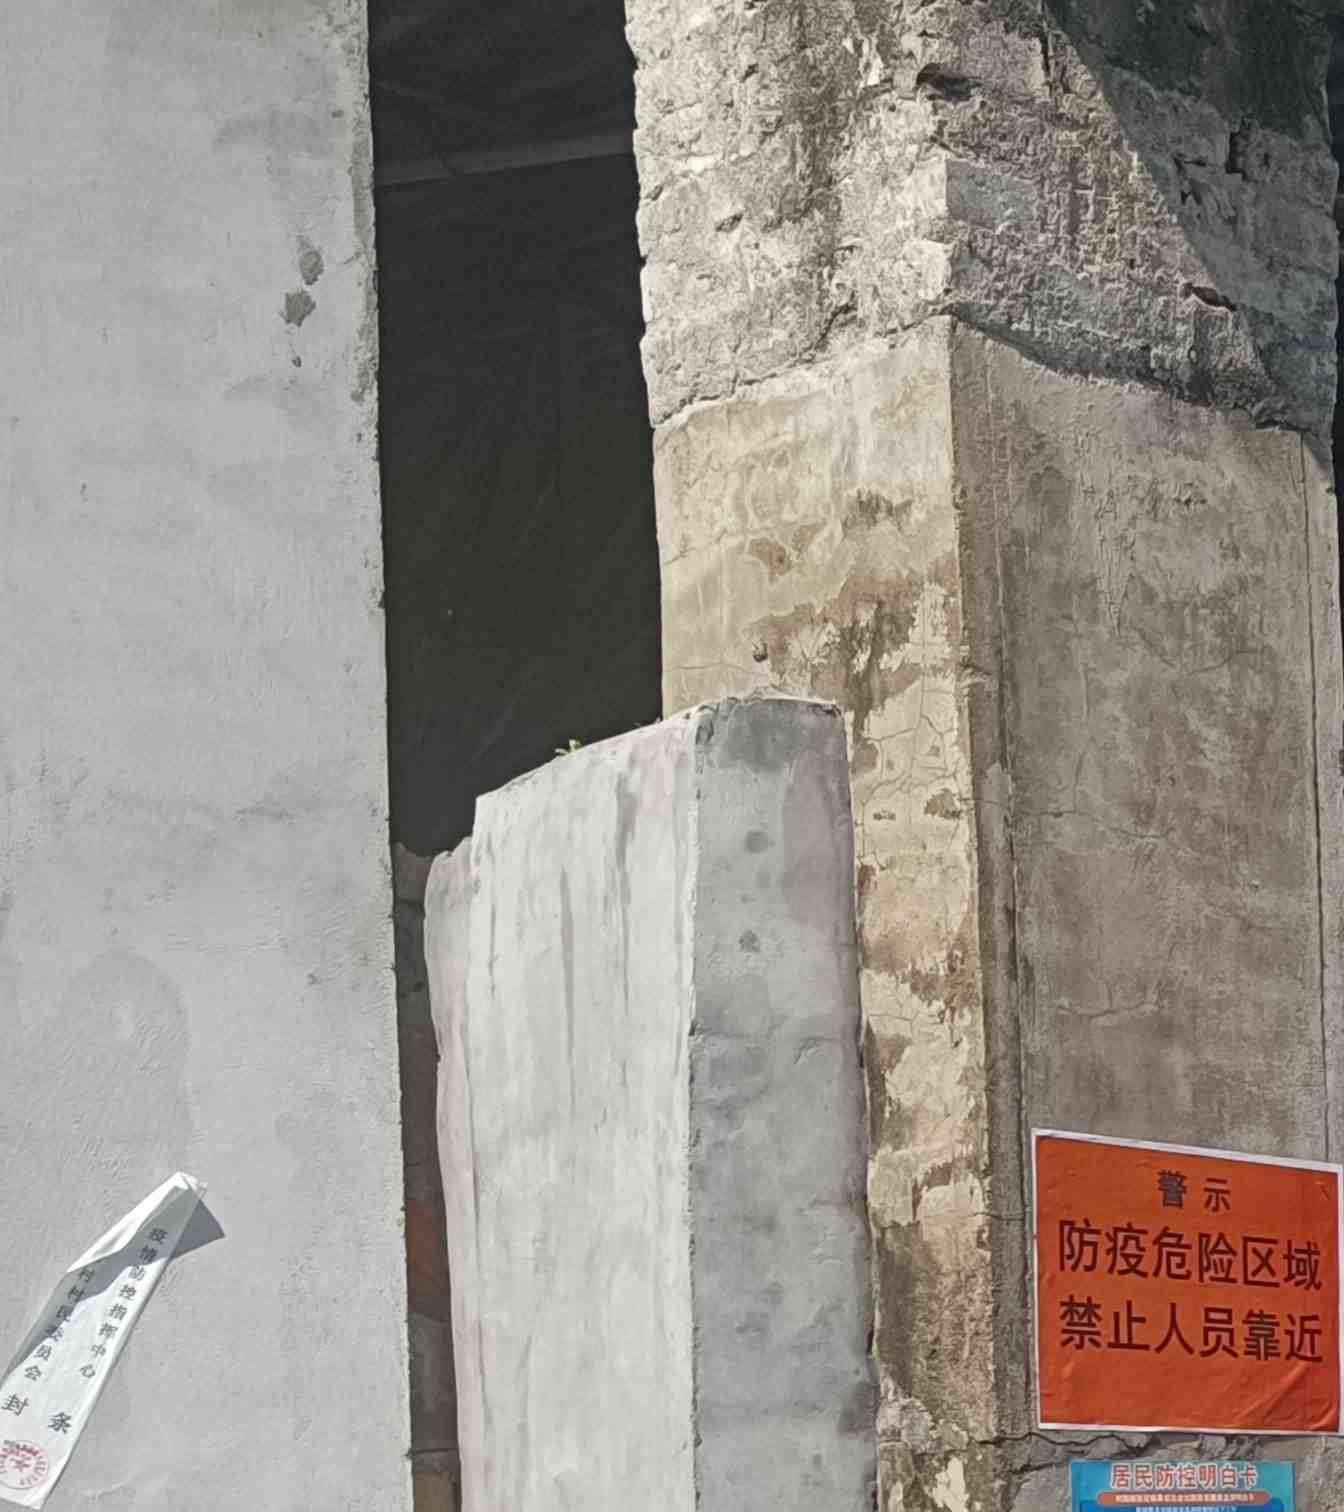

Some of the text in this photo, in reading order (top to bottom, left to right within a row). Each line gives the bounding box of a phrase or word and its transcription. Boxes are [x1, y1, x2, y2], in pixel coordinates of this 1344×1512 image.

[1156, 1169, 1232, 1213] 警示
[1058, 1218, 1323, 1291] 防疫危险区域
[79, 1227, 169, 1379] 疫情防控指挥中心
[1058, 1294, 1324, 1363] 禁止人员靠近
[1, 1393, 73, 1435] 封条
[1110, 1462, 1259, 1490] 居民防控明白卡
